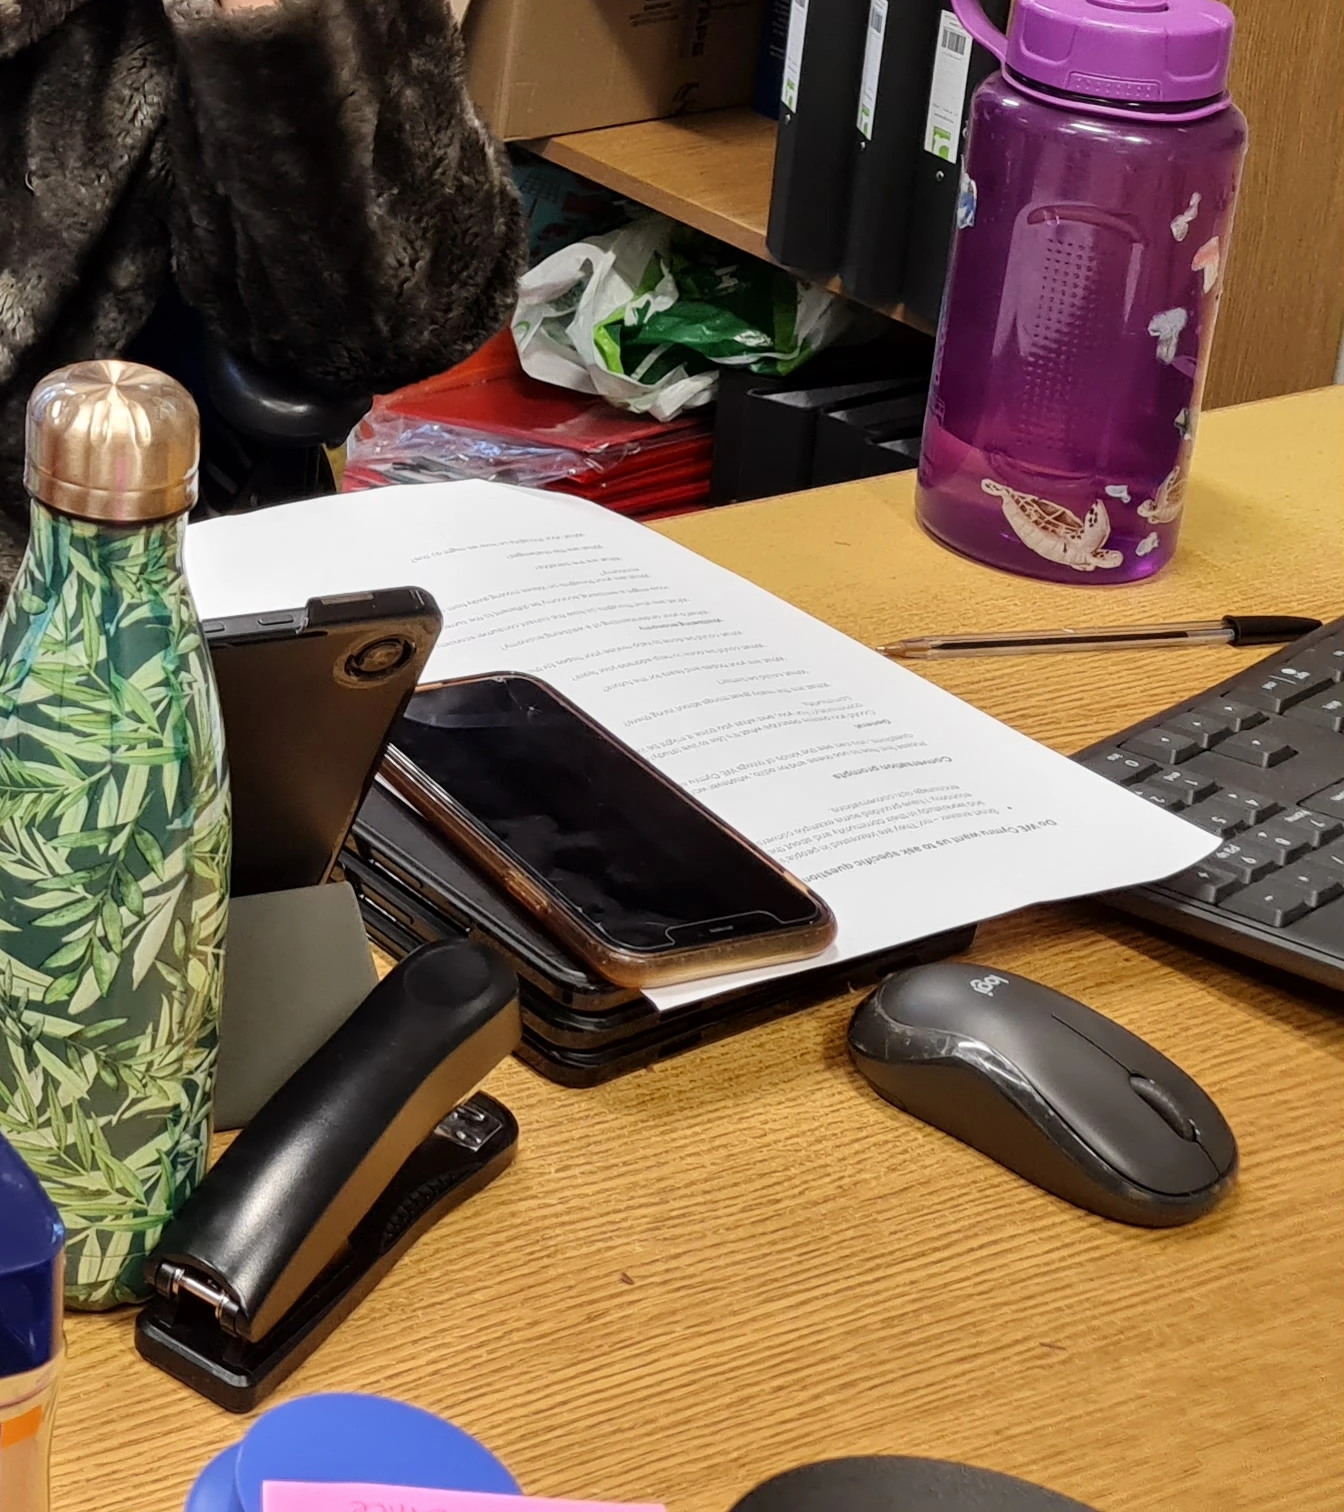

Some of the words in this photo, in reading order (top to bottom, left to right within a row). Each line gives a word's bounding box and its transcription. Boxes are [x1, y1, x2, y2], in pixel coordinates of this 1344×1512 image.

[880, 756, 953, 772] Conversation
[832, 765, 880, 780] prompts
[1018, 822, 1036, 834] WE
[1038, 819, 1057, 828] Do
[980, 826, 1018, 837] Cymru
[936, 838, 951, 847] us
[951, 832, 981, 844] want
[900, 846, 922, 856] ask
[922, 843, 937, 851] to
[853, 851, 900, 867] specific
[970, 974, 1010, 997] logi
